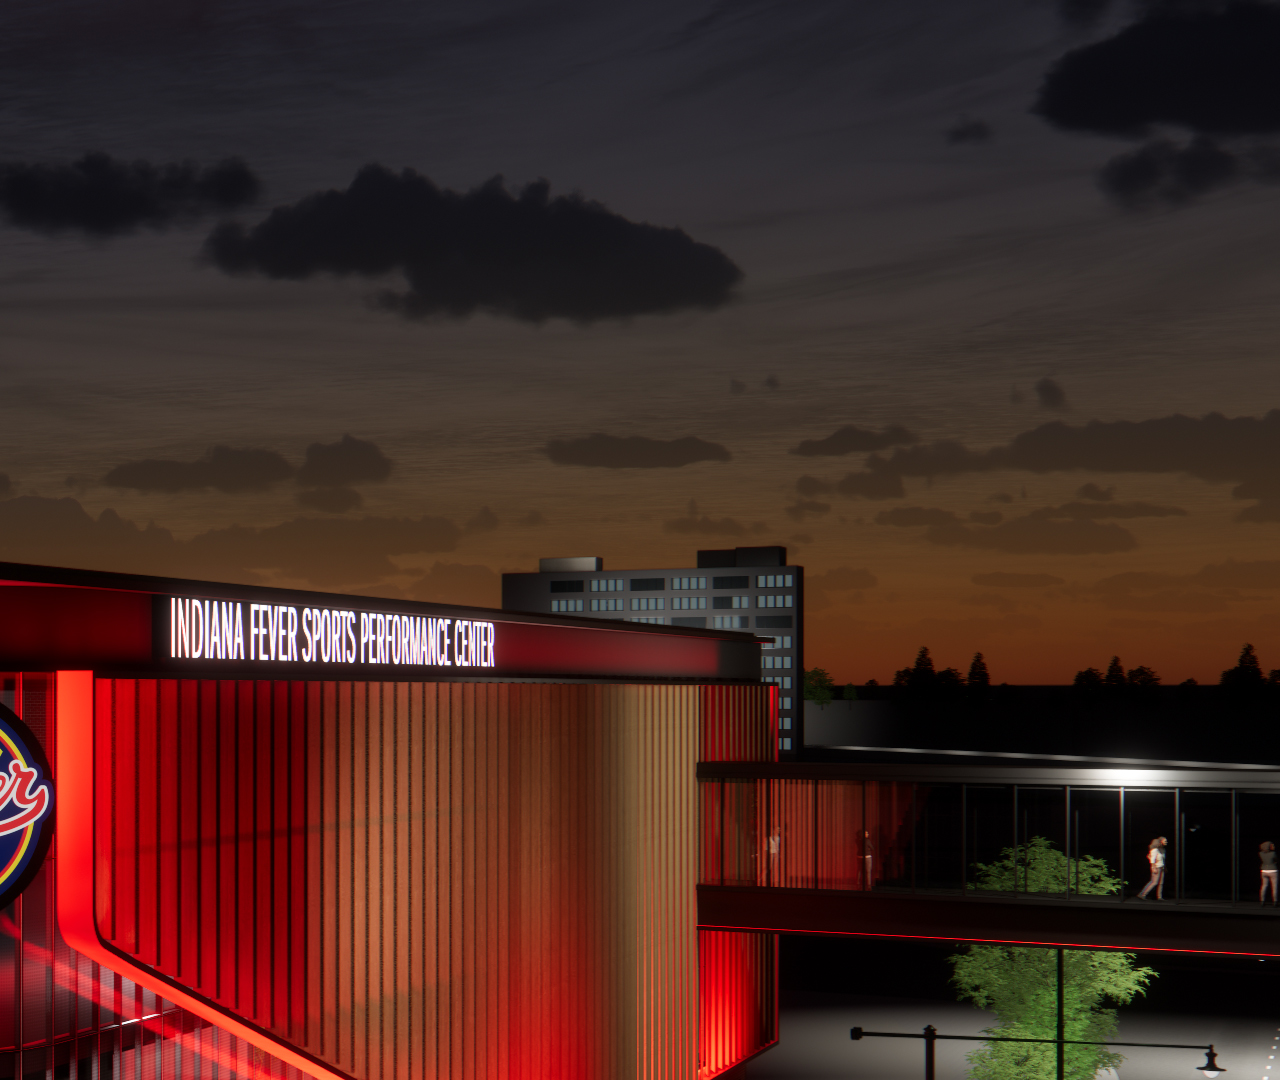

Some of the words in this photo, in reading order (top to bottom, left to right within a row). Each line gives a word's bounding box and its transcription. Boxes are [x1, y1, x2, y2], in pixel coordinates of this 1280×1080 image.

[170, 597, 245, 660] INDIANA
[250, 603, 298, 662] FEVER
[301, 607, 357, 664] SPORTS
[360, 612, 452, 667] PERFORMANCE
[454, 619, 496, 668] CENTER
